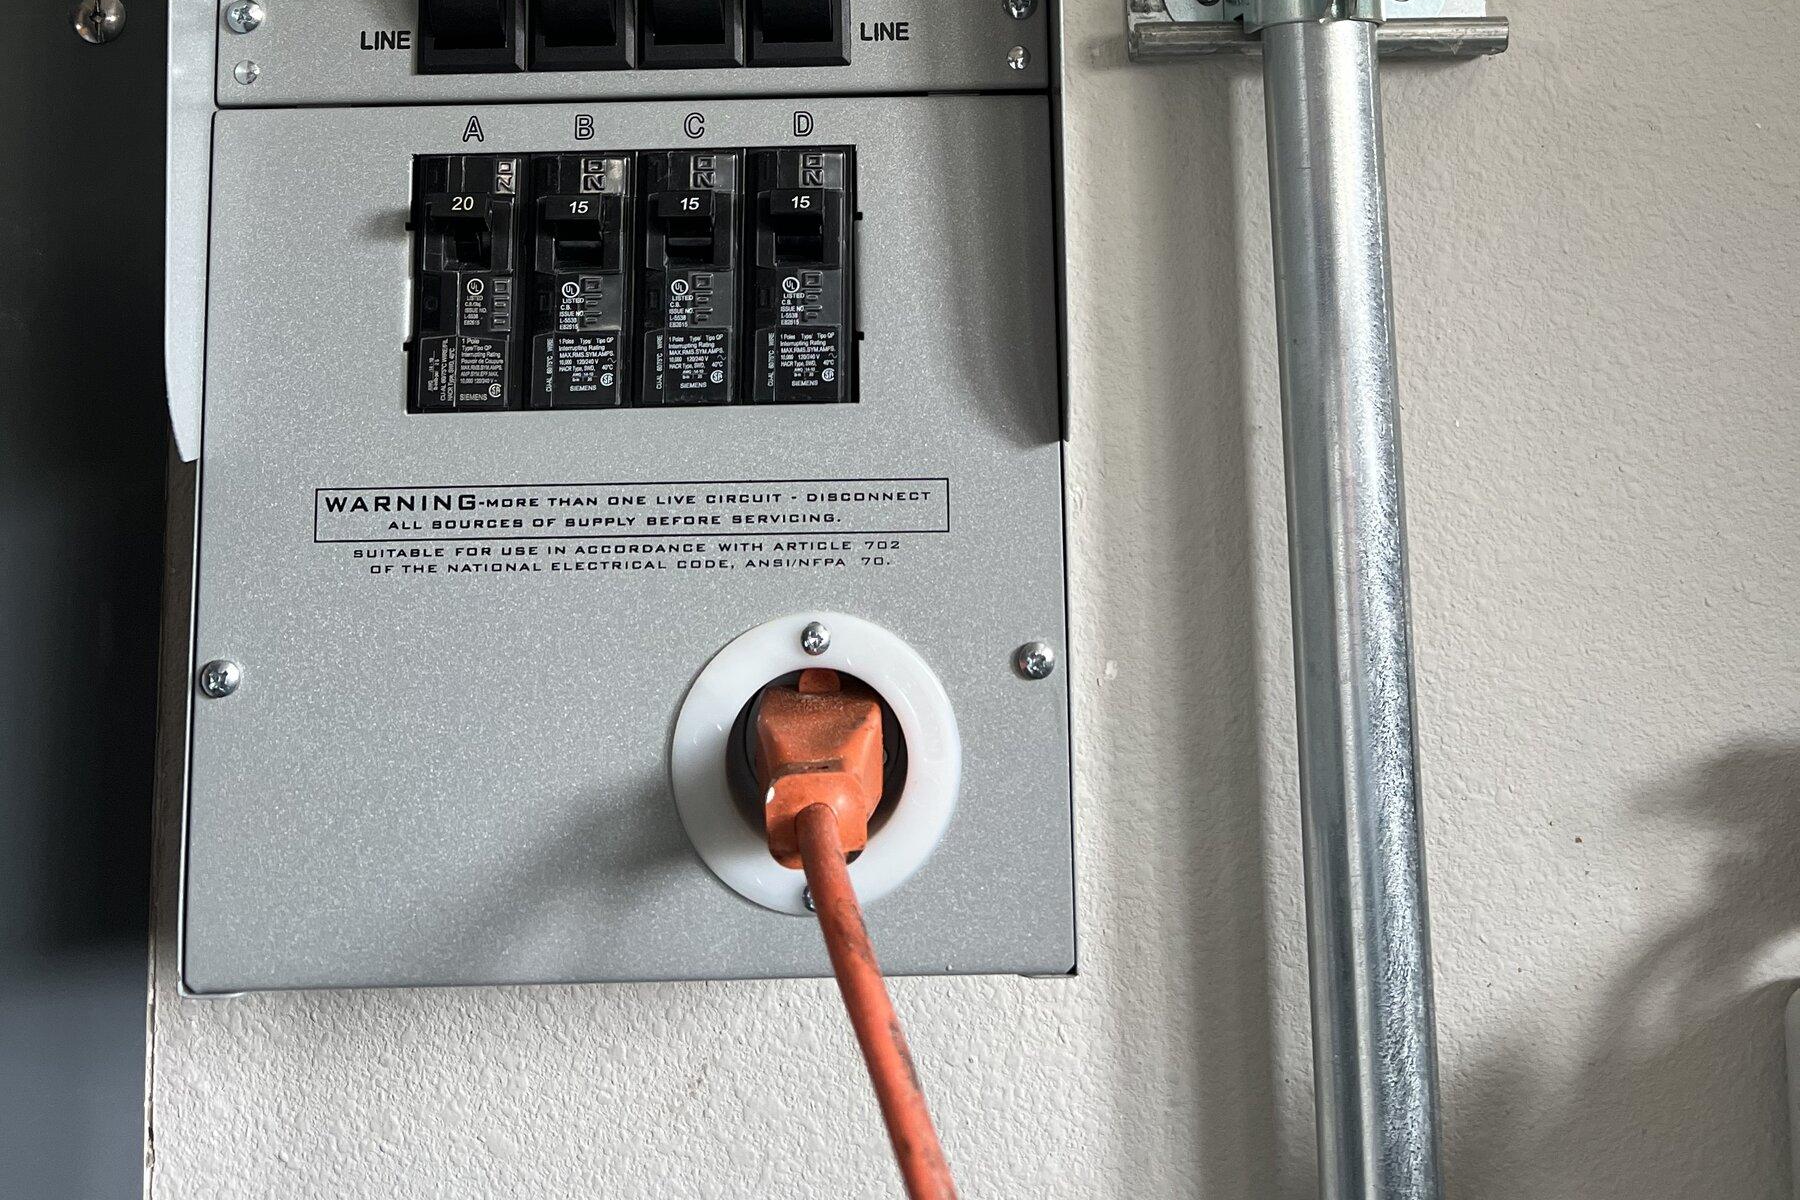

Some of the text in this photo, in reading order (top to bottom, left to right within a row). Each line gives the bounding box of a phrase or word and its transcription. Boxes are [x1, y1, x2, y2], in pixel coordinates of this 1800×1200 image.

[860, 21, 909, 41] LINE
[360, 28, 412, 50] LINE
[462, 115, 484, 142] A
[574, 114, 594, 140] B
[684, 112, 704, 139] C
[793, 111, 813, 137] D
[452, 196, 473, 210] 20
[570, 201, 588, 214] 15
[680, 197, 699, 210] 15
[792, 196, 810, 209] 15
[569, 384, 597, 392] SIEMENS
[680, 381, 707, 389] SIEMENS
[791, 379, 818, 387] SIEMENS
[459, 393, 488, 402] SIEMENS
[547, 497, 597, 507] THAN
[608, 496, 646, 506] ONE
[656, 495, 695, 505] LIVE
[706, 493, 781, 504] CIRCUIT
[807, 492, 930, 502] DISCONNECT
[388, 521, 422, 530] ALL
[432, 519, 522, 530] SOURCES
[532, 518, 556, 528] OF
[565, 517, 635, 528] SUPPLY
[647, 516, 720, 526] BEFORE
[354, 541, 899, 559] SUITABLE FOR USE IN ACCORDANCE WITH ARTICLE 702
[370, 565, 394, 574] OF
[402, 564, 437, 574] THE
[448, 563, 541, 573] NATIONAL
[551, 561, 666, 571] ELECTRICAL
[745, 558, 845, 568] ANSI/NFPA
